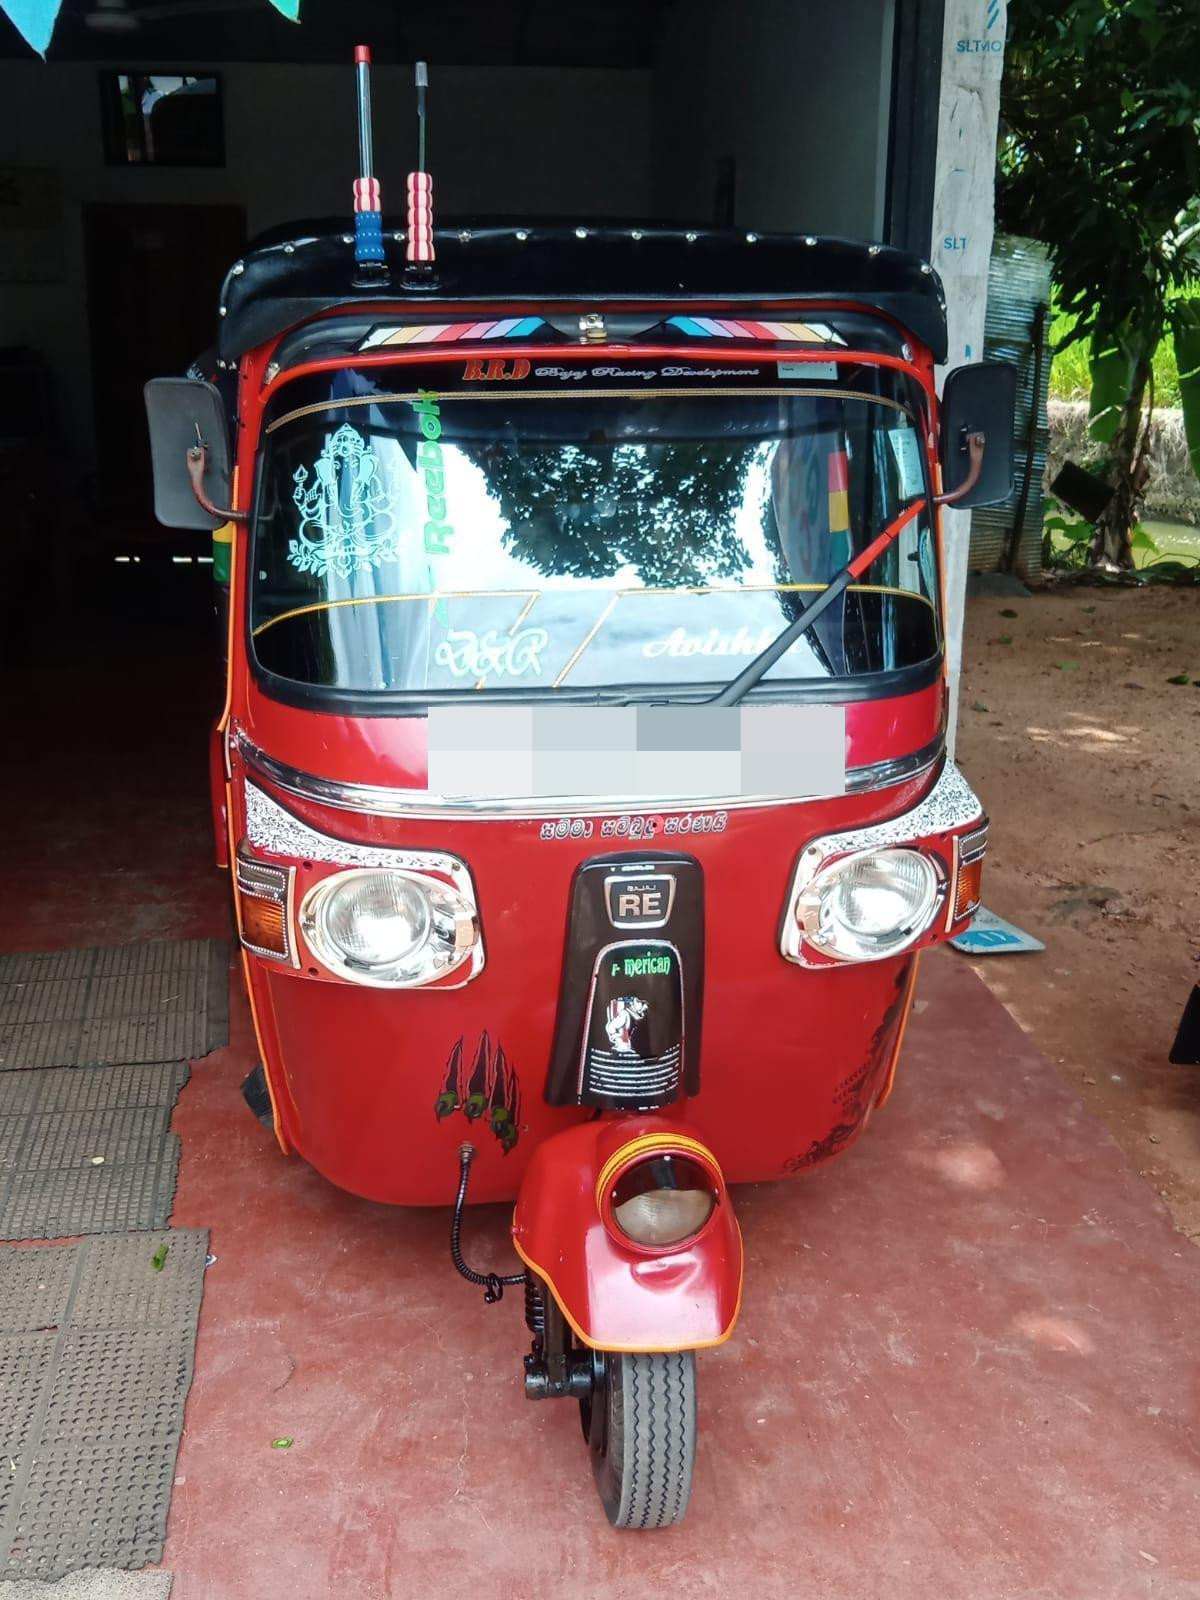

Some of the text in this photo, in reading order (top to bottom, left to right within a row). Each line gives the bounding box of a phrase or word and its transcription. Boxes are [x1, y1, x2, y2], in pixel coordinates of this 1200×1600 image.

[943, 237, 968, 250] SLT
[591, 366, 657, 381] Racing
[412, 388, 455, 555] Reebok
[618, 893, 662, 917] RE
